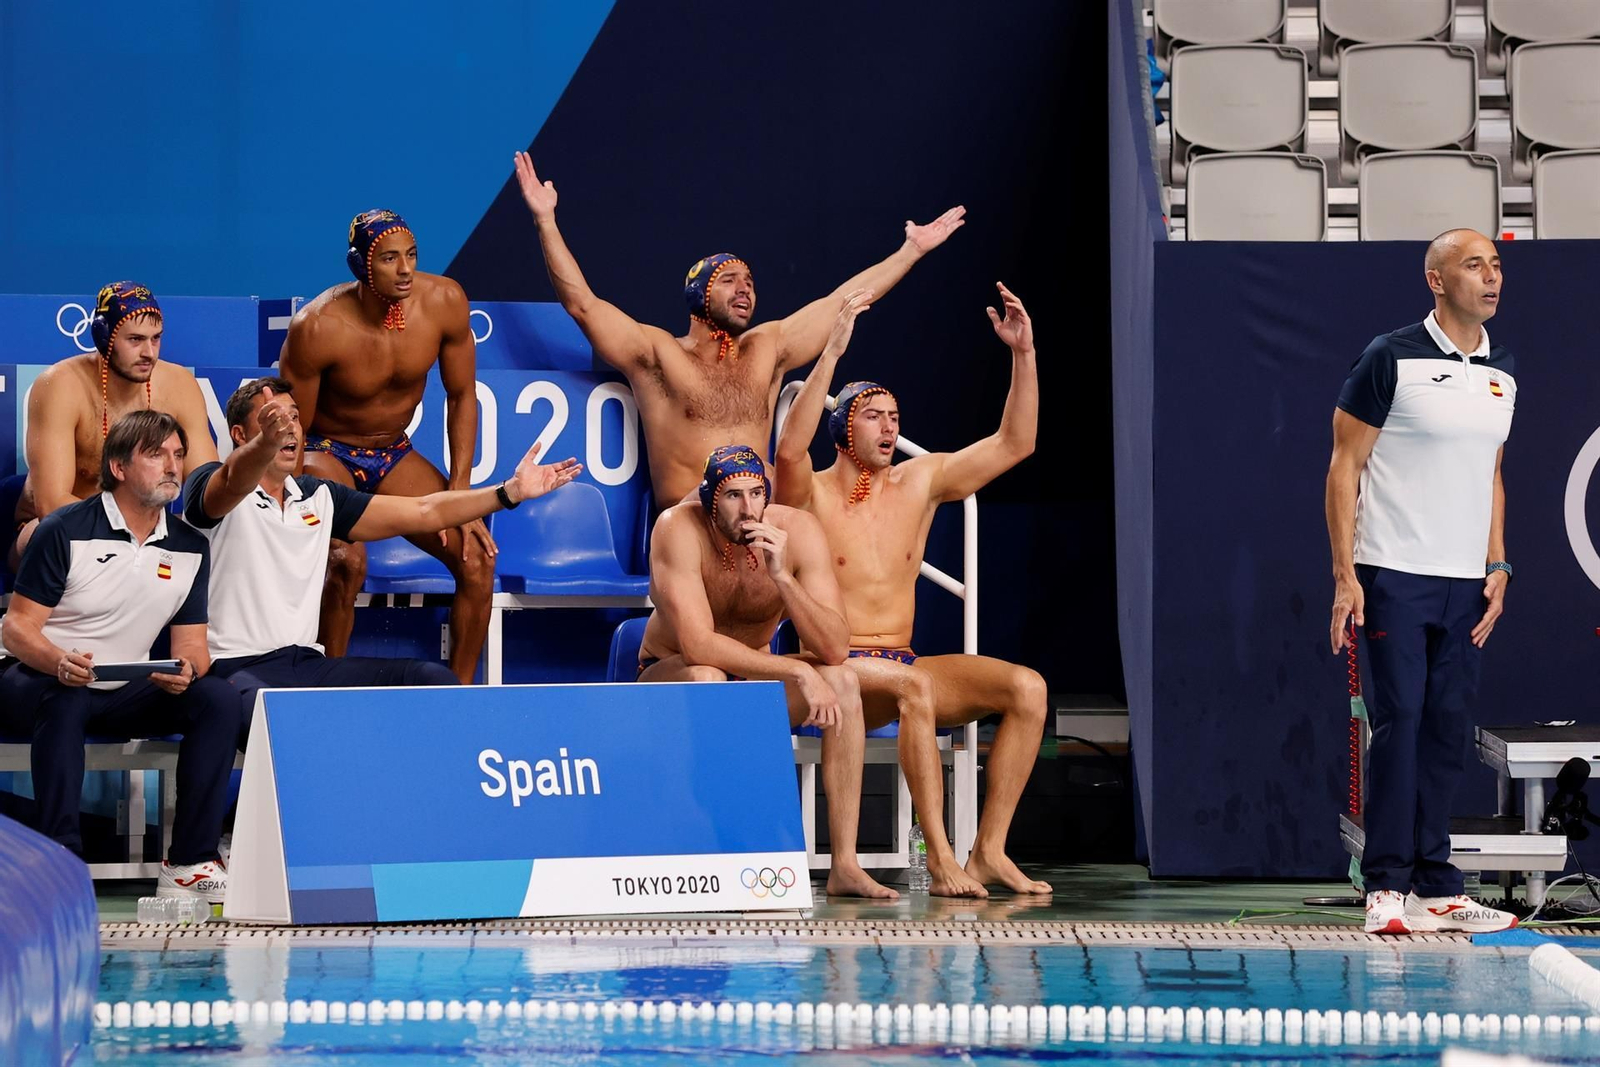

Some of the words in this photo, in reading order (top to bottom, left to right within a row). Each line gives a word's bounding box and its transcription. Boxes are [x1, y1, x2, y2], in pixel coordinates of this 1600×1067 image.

[404, 380, 639, 486] 020
[478, 747, 601, 807] Spain
[197, 879, 228, 891] ESPAÑ
[612, 876, 672, 896] TOKYO
[676, 875, 720, 894] 2020
[1451, 909, 1501, 921] ESPAÑA
